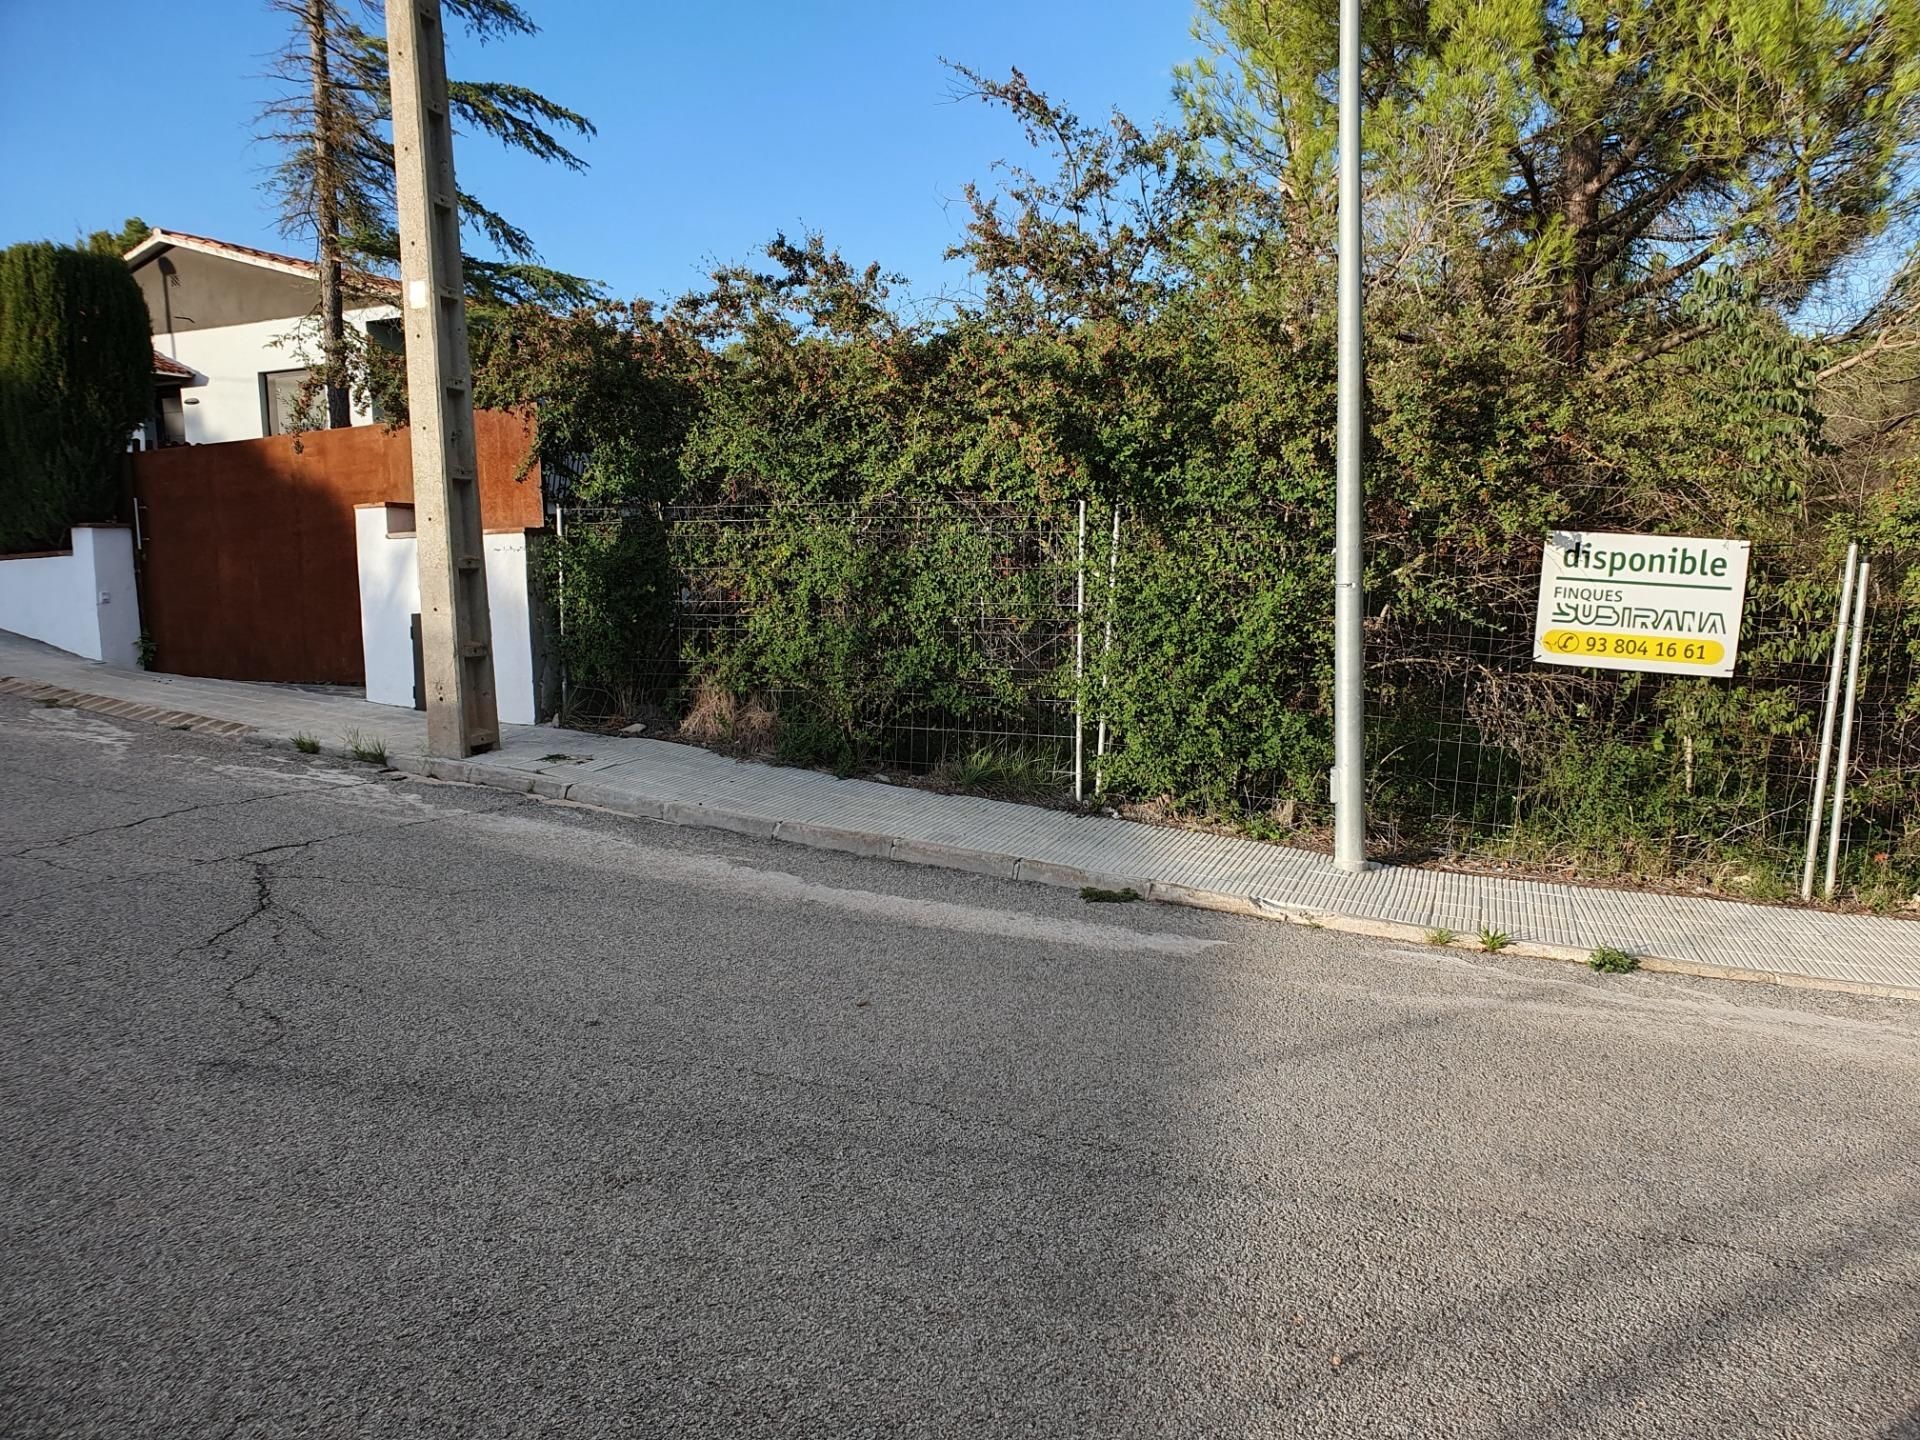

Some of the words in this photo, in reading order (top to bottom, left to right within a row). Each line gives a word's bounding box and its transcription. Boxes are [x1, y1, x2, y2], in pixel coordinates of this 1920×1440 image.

[1563, 542, 1727, 577] disponible
[1553, 586, 1623, 602] FINQUES
[1551, 602, 1726, 635] SUBIRANA
[1586, 636, 1607, 652] 93
[1613, 639, 1649, 655] 804
[1655, 641, 1677, 657] 16
[1683, 643, 1706, 660] 61
